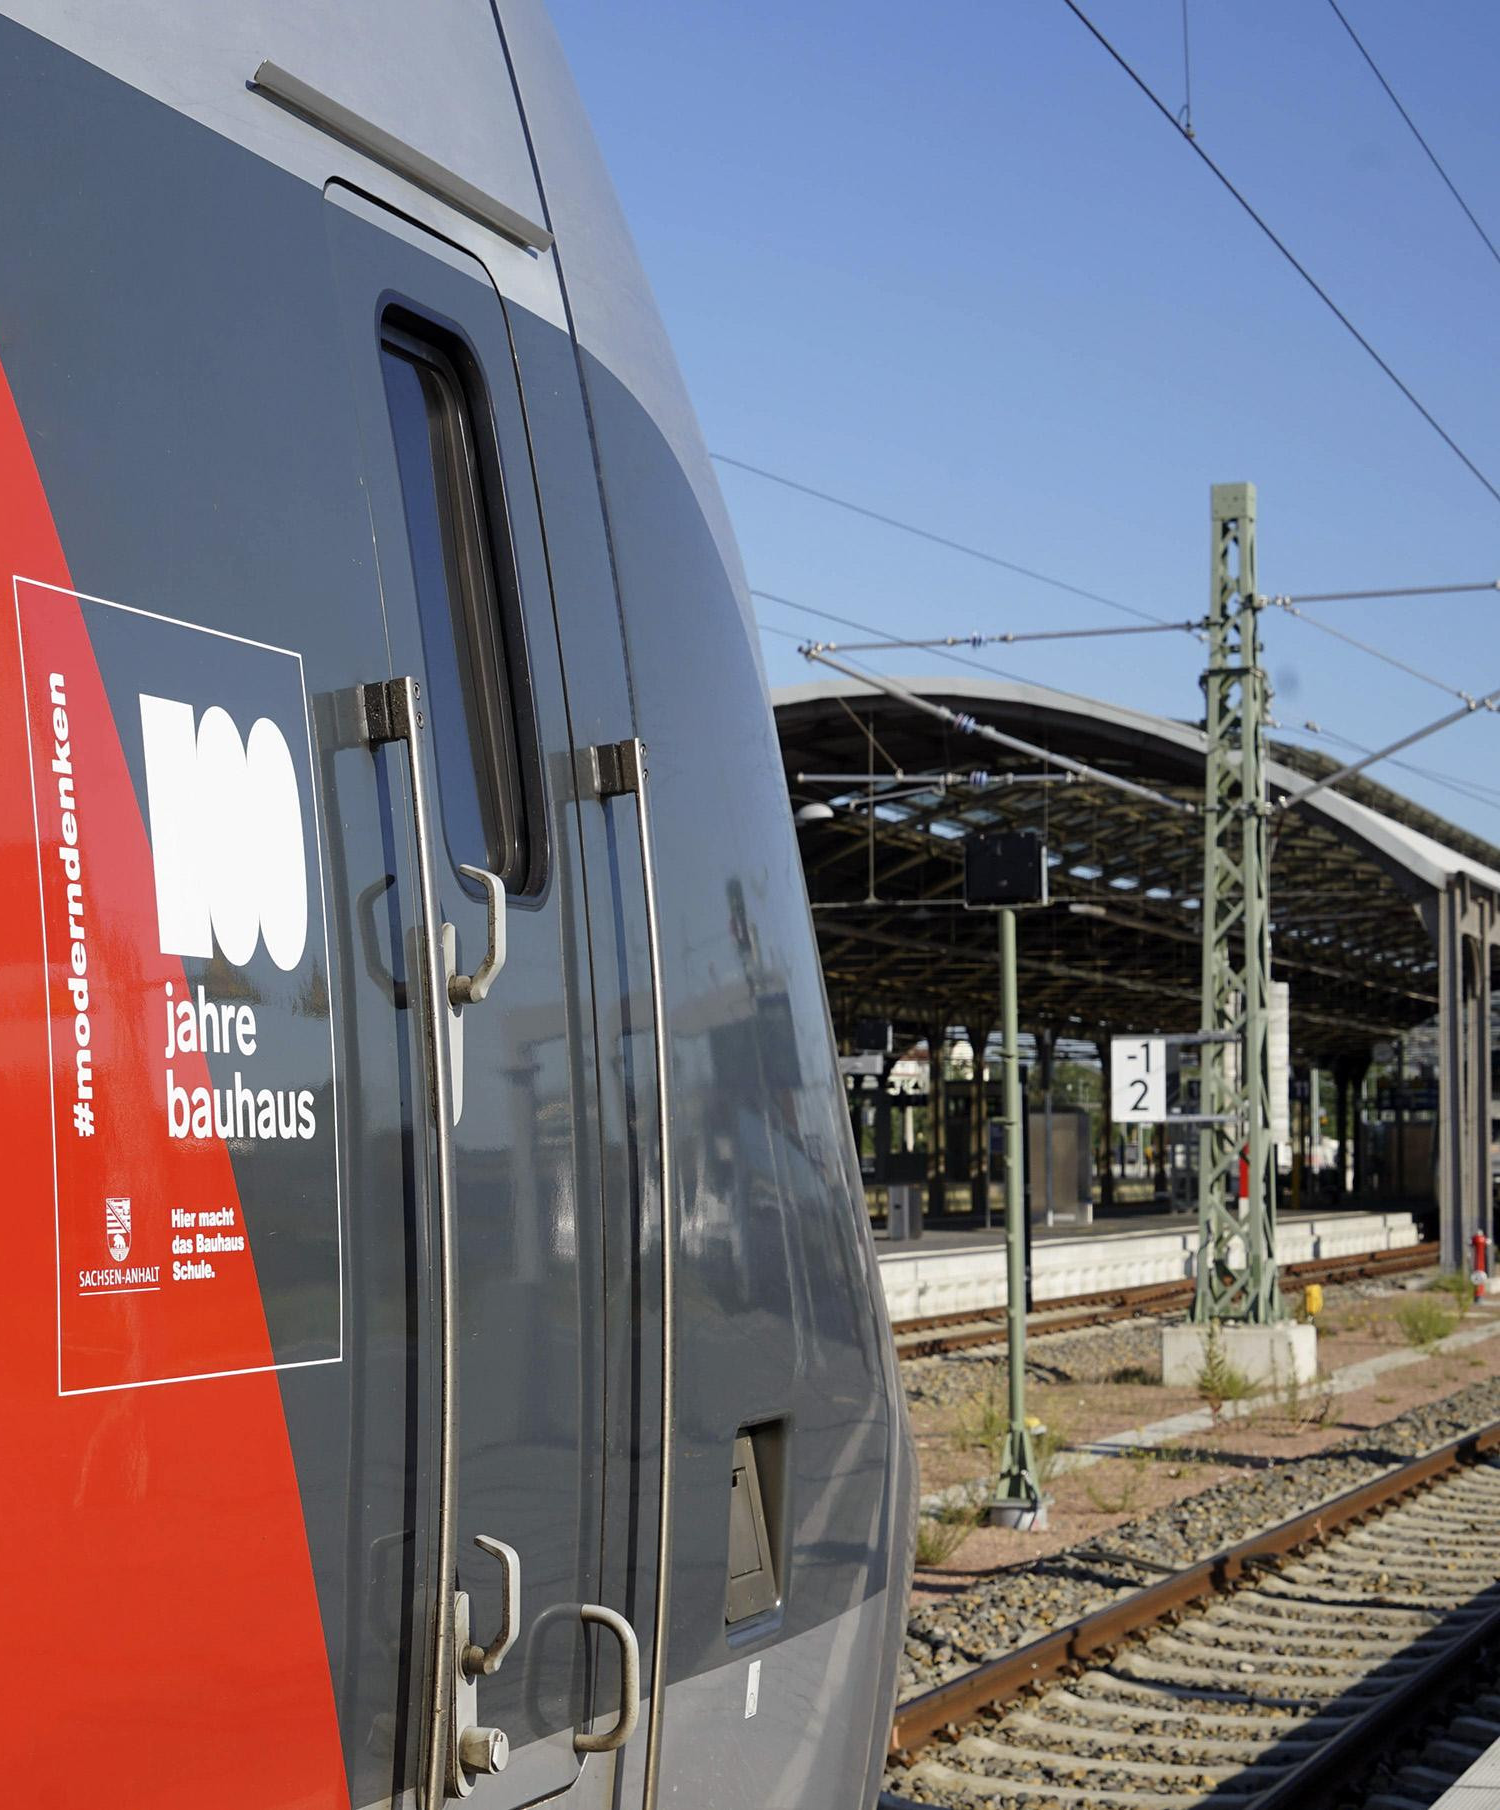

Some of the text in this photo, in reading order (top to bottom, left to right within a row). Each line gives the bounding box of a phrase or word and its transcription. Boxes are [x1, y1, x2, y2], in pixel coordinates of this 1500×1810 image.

[49, 673, 95, 1137] #moderndenken
[165, 981, 257, 1059] jahre
[166, 1069, 316, 1140] bauhaus
[1129, 1080, 1149, 1111] 2
[171, 1206, 235, 1228] Hier macht
[171, 1232, 245, 1255] das Bauhaus
[79, 1266, 160, 1287] SACHSEN-ANHALT
[172, 1259, 216, 1281] Schule.
